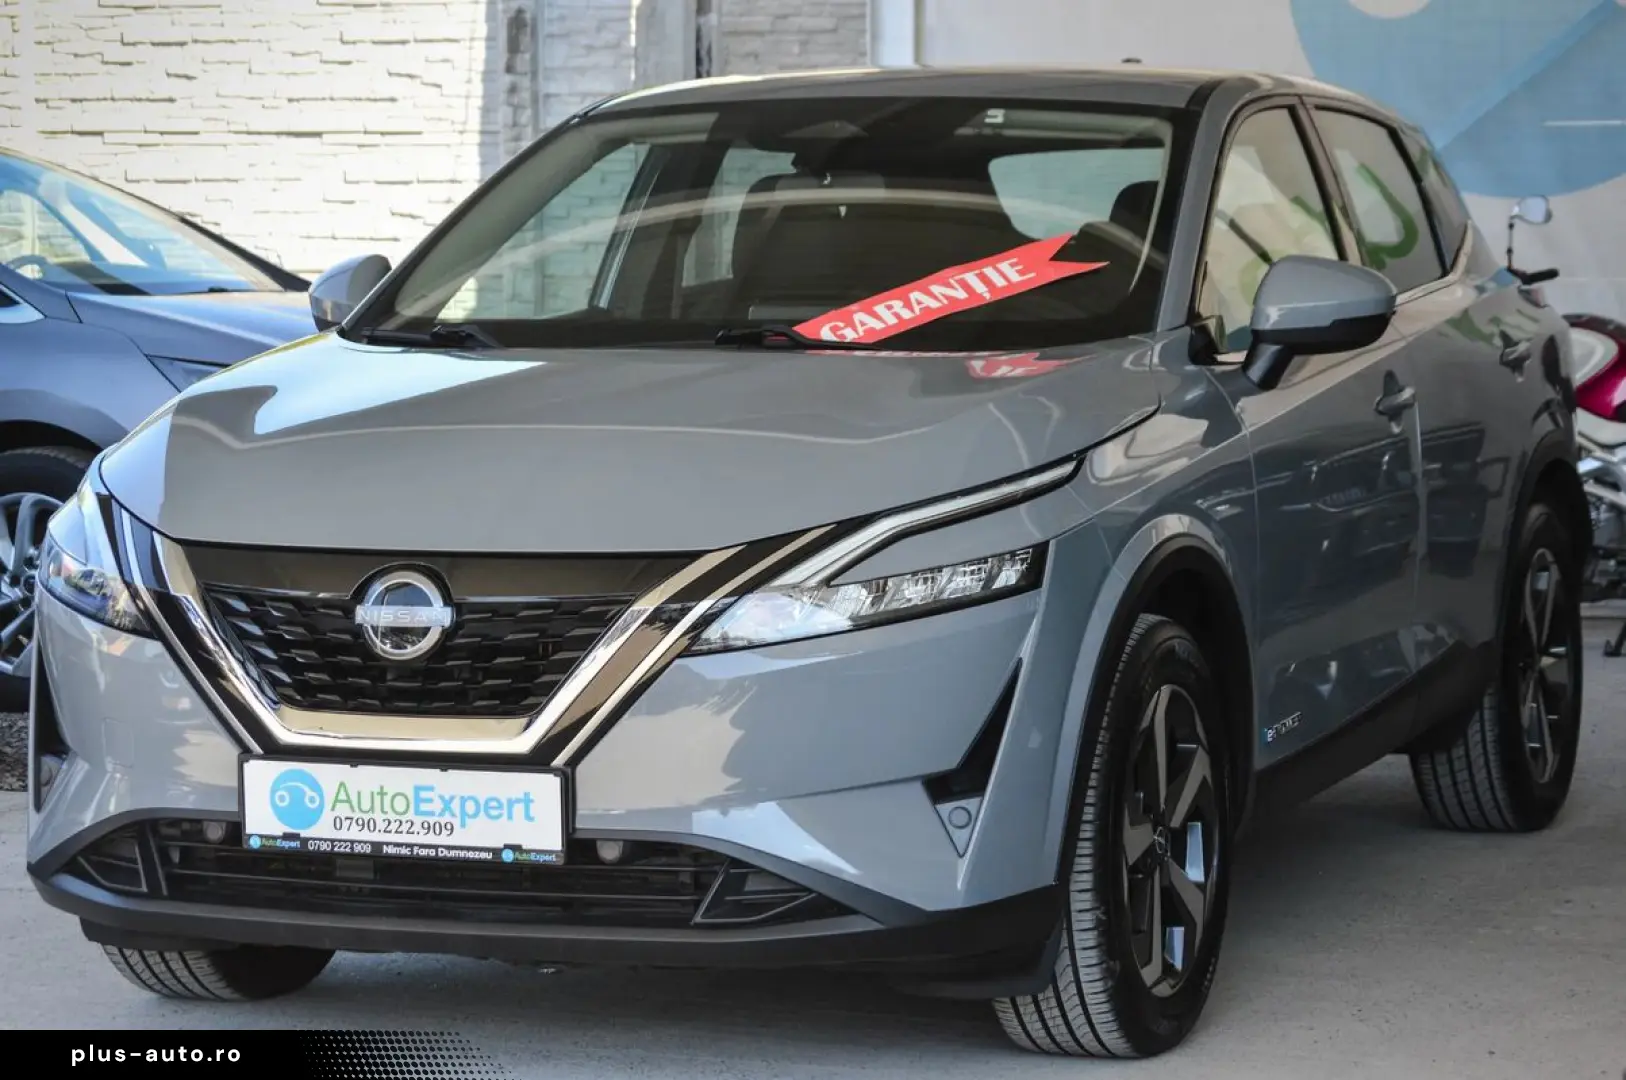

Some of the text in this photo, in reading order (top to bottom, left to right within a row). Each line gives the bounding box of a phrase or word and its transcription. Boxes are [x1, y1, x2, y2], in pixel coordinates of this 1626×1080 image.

[819, 256, 1036, 342] GARANȚIE
[356, 609, 448, 625] NISSAN
[330, 780, 536, 828] AutoExpert
[332, 814, 455, 837] 0790.222.909
[307, 840, 372, 854] 0790 222 909
[382, 844, 411, 854] Nimic
[413, 846, 435, 856] Fara
[514, 851, 557, 862] AutoExpert
